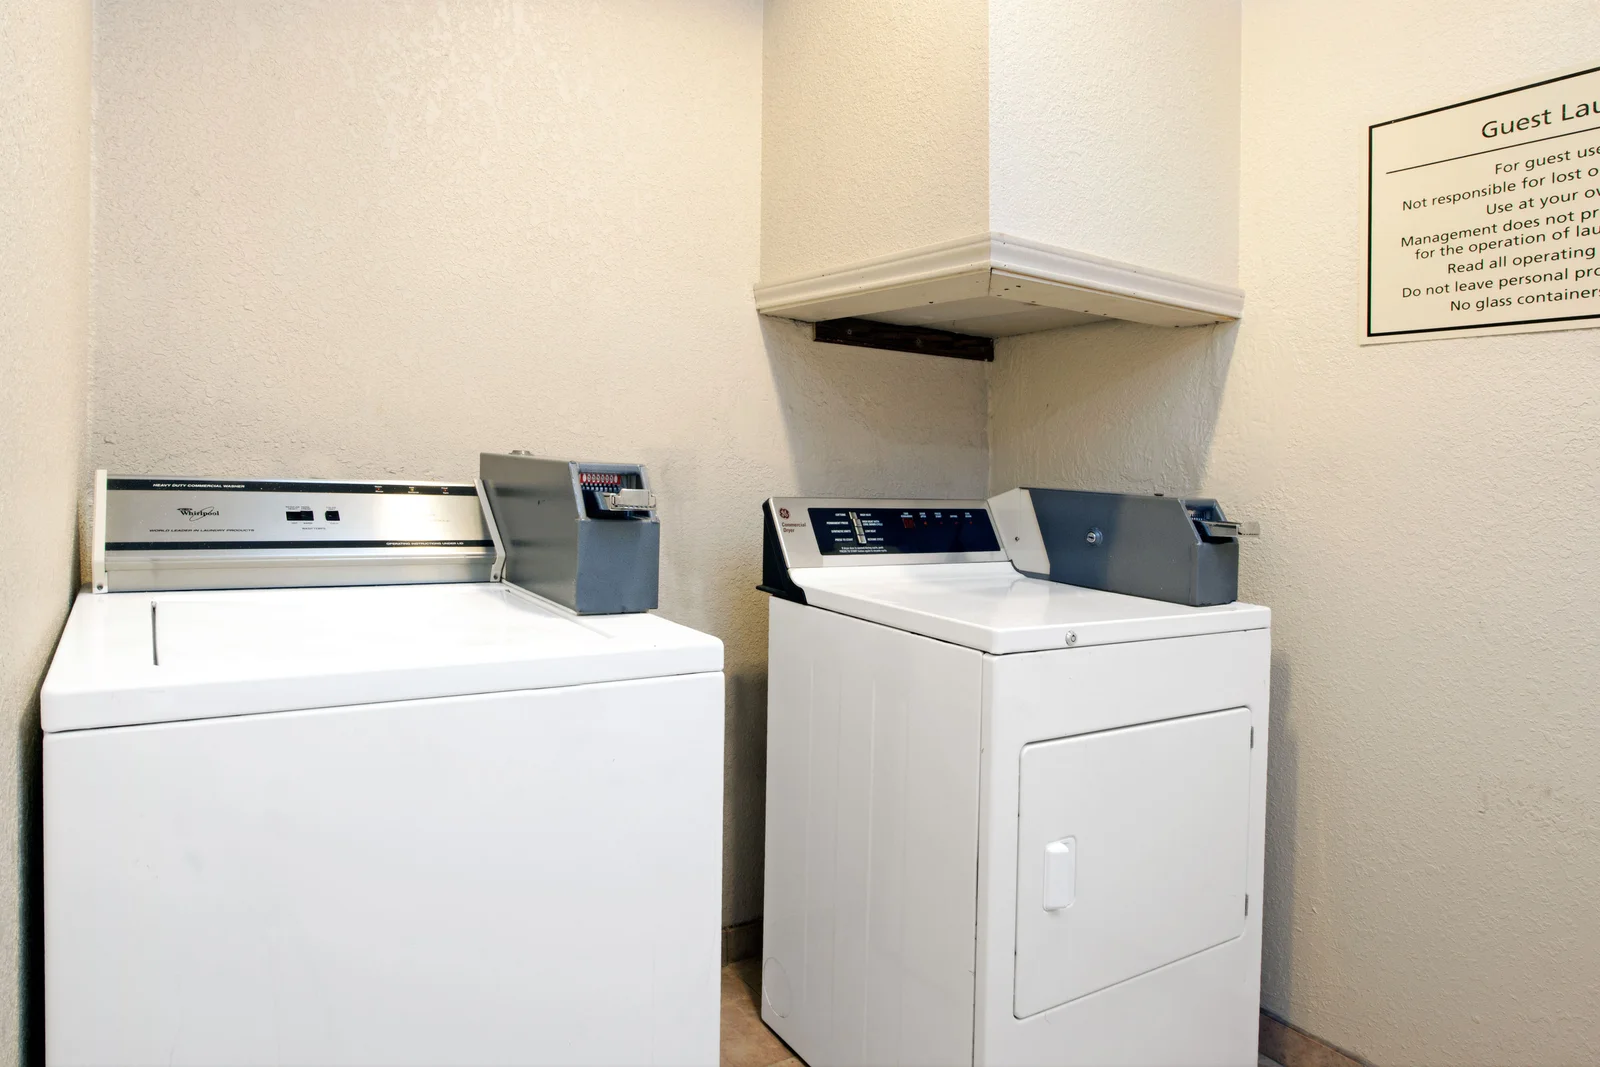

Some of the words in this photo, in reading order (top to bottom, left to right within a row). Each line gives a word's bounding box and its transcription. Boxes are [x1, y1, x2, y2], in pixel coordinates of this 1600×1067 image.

[1482, 109, 1552, 139] Guest
[1495, 161, 1520, 175] For
[1525, 150, 1571, 172] guest
[1402, 198, 1428, 211] Not
[1432, 180, 1516, 206] responsible
[1522, 176, 1546, 190] for
[1552, 168, 1582, 184] lost
[1486, 203, 1513, 215] Use
[1519, 197, 1535, 210] at
[1540, 192, 1579, 210] your
[1401, 224, 1498, 248] Management
[1502, 219, 1540, 232] does
[1545, 211, 1575, 226] not
[1581, 208, 1600, 223] pr
[1415, 248, 1436, 260] for
[1440, 244, 1464, 256] the
[1469, 233, 1546, 254] operation
[1552, 226, 1571, 241] of
[1448, 260, 1484, 275] Read
[1489, 256, 1507, 269] all
[1512, 247, 1596, 270] operating
[1402, 287, 1421, 298] Do
[1425, 284, 1450, 296] not
[1455, 280, 1494, 293] leave
[1499, 267, 1568, 291] personal
[1450, 300, 1471, 312] No
[1476, 297, 1513, 312] glass
[1517, 287, 1600, 305] container
[179, 508, 219, 519] Whirlpool
